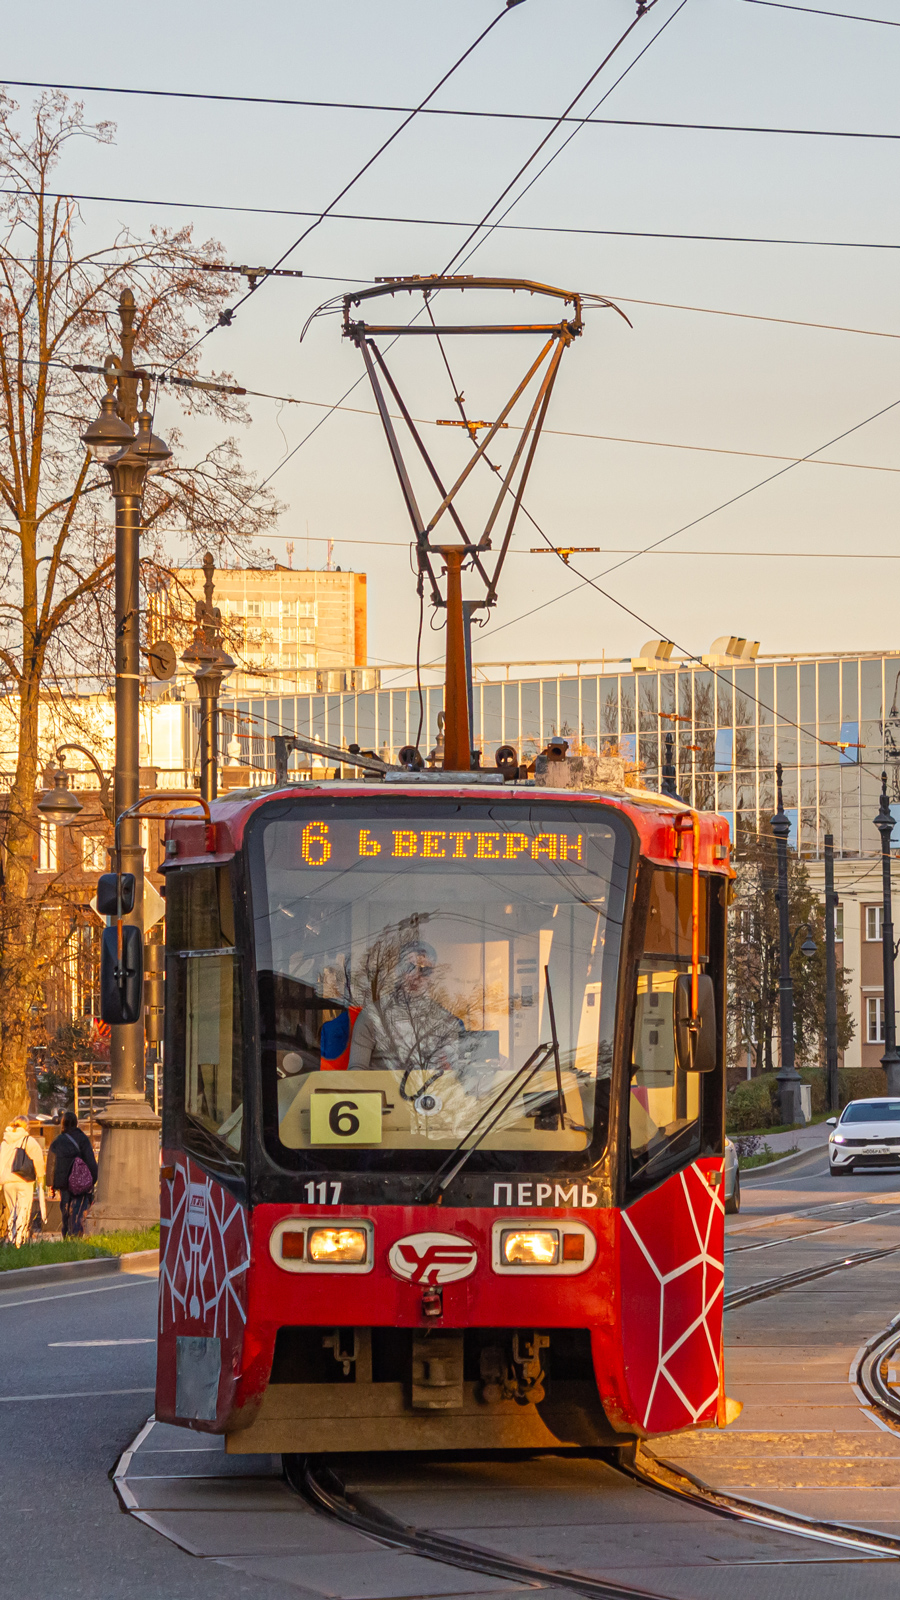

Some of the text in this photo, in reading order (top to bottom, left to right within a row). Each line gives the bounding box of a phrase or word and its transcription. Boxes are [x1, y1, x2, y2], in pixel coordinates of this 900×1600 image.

[301, 821, 332, 866] 6
[391, 830, 583, 860] ВЕТЕРАН
[328, 1100, 360, 1137] 6
[304, 1181, 342, 1205] 117
[493, 1182, 598, 1208] ПЕРМЬ
